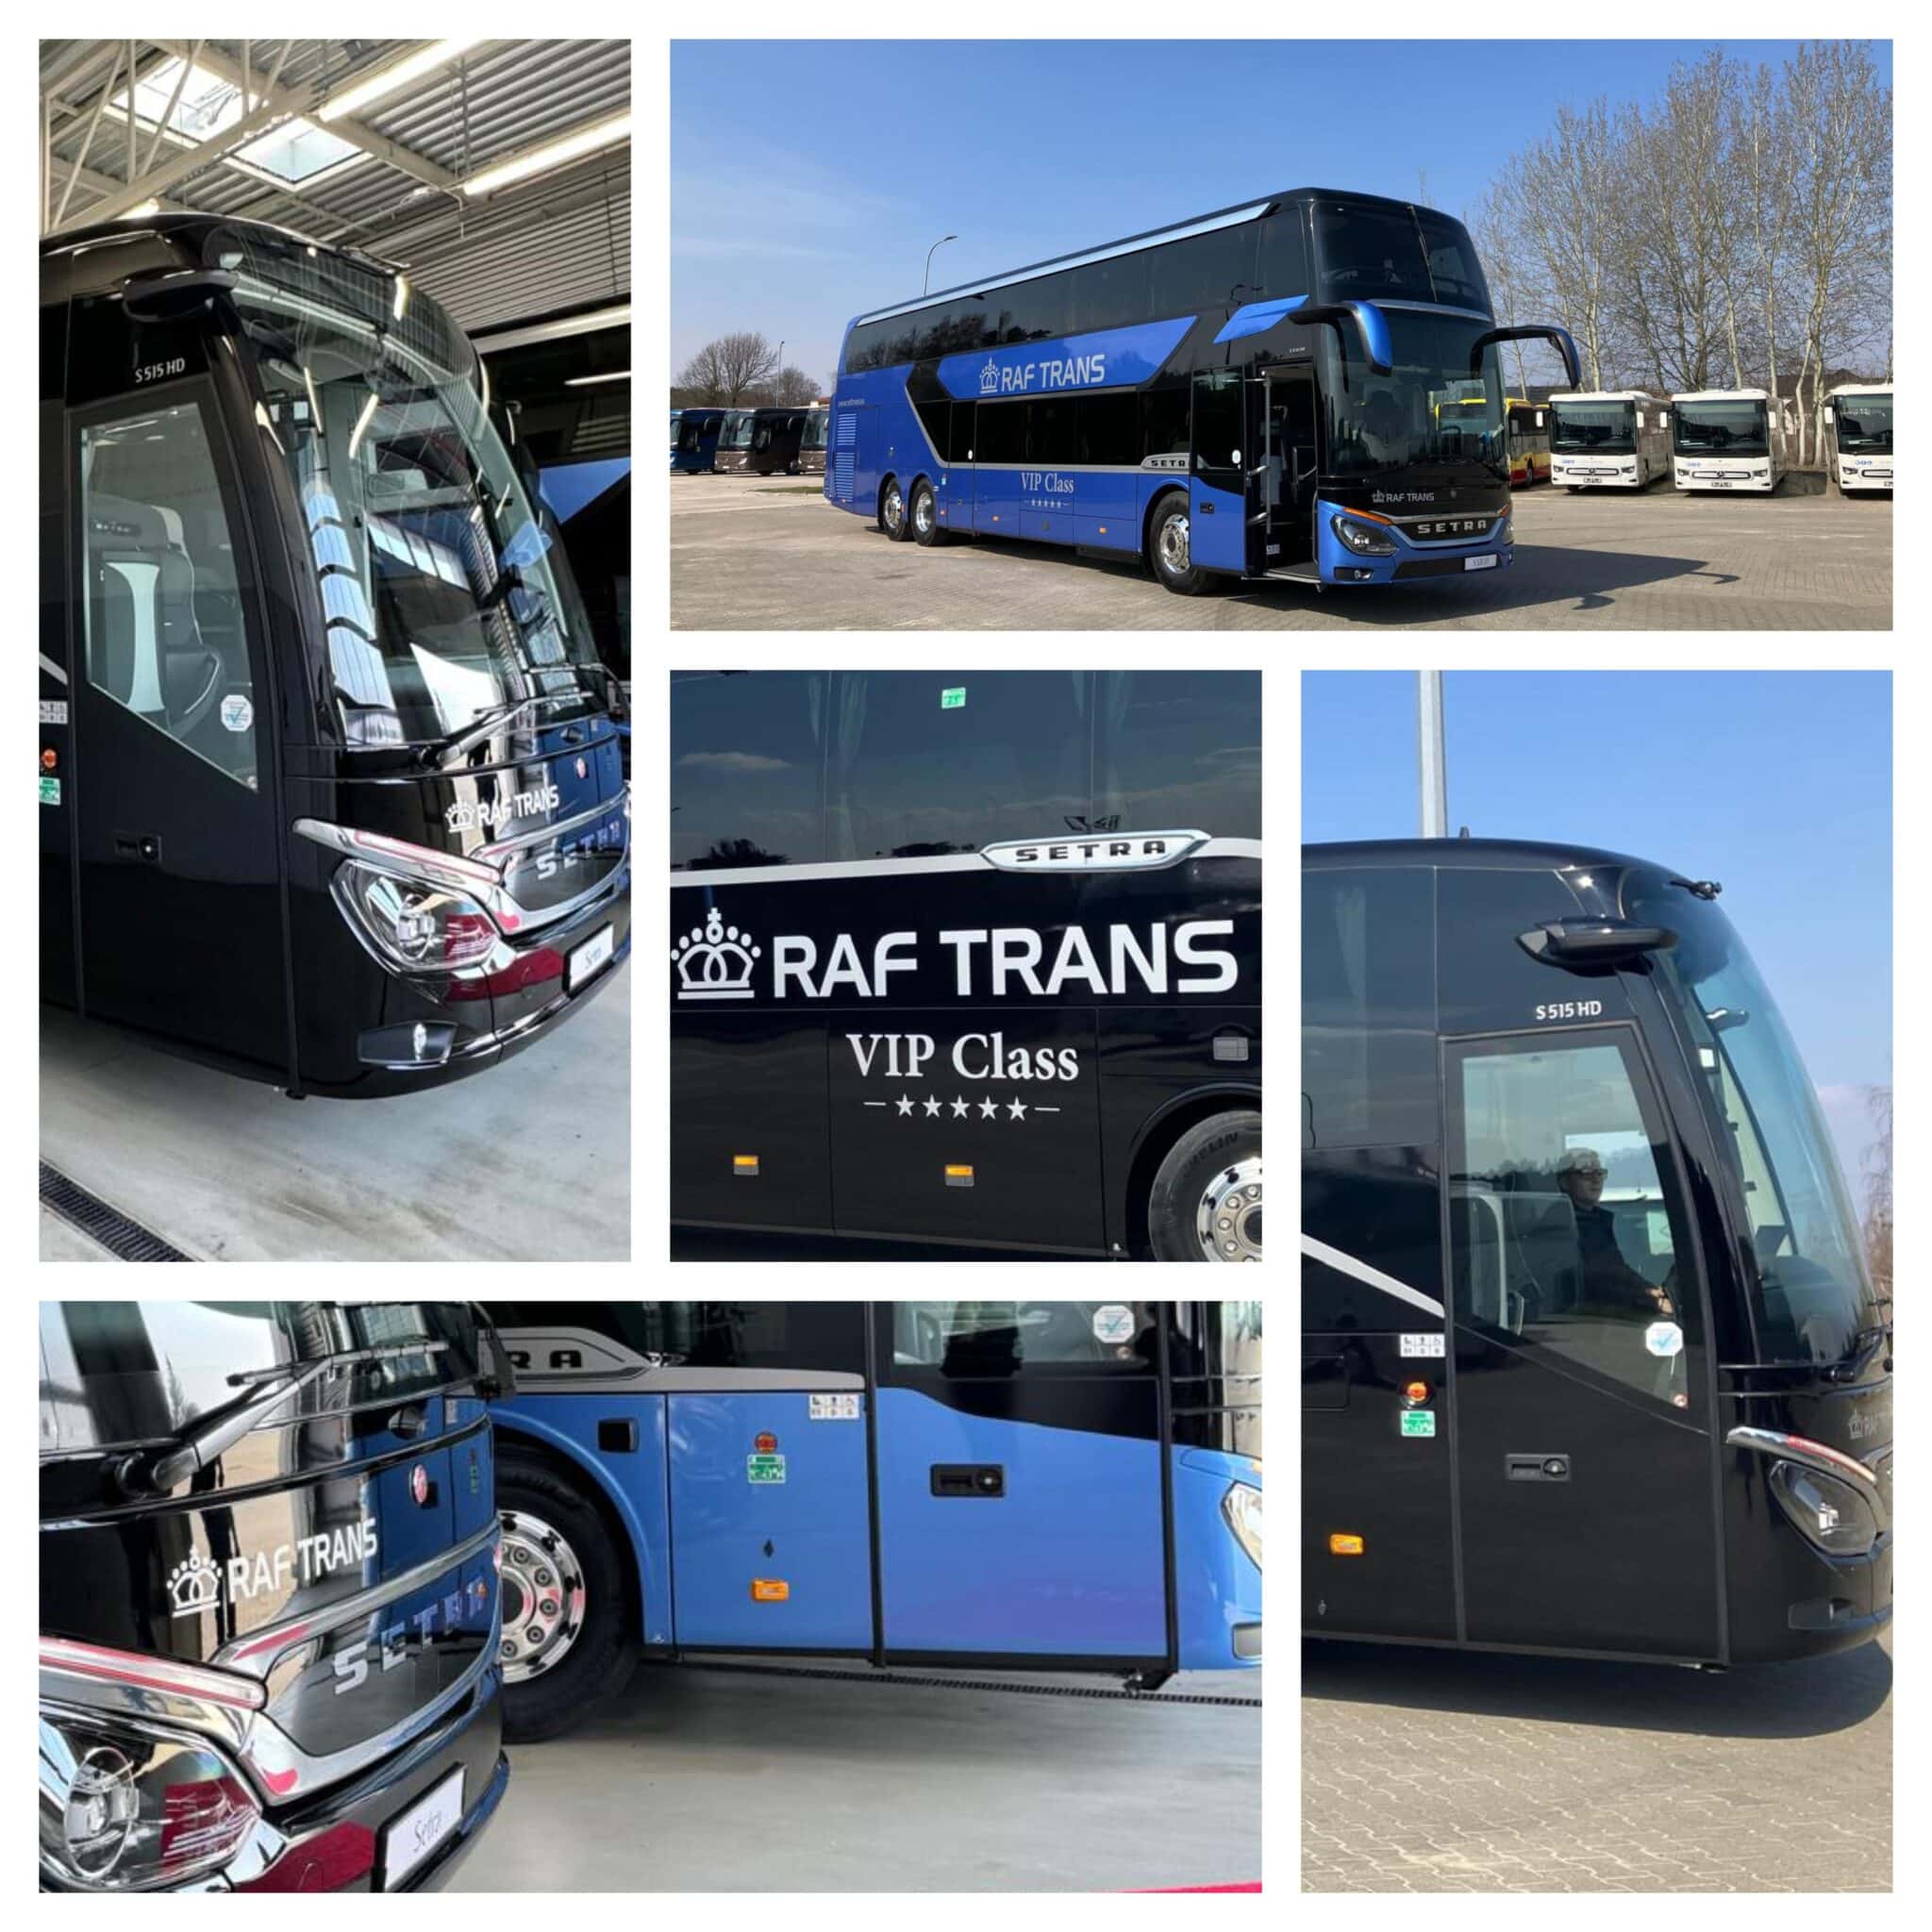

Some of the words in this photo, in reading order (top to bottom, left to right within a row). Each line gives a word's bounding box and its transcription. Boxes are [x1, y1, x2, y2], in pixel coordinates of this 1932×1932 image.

[135, 368, 143, 384] S
[143, 362, 164, 381] 515
[165, 357, 186, 375] HD
[1002, 363, 1035, 391] RAF
[1040, 354, 1106, 389] TRANS
[1151, 459, 1187, 468] SETR
[1019, 472, 1041, 491] VIP
[1044, 472, 1074, 493] Class
[1386, 491, 1405, 502] RAF
[1406, 491, 1435, 502] TRANS
[1417, 520, 1487, 534] SETRA
[476, 798, 513, 826] RAF
[514, 785, 560, 818] TRANS
[1015, 840, 1166, 862] SETRA
[774, 930, 918, 998] RAF
[939, 920, 1240, 996] TRANS
[1536, 1005, 1546, 1020] S
[1548, 1002, 1574, 1020] 515
[1576, 1000, 1602, 1017] HD
[846, 1032, 936, 1077] VIP
[952, 1030, 1079, 1081] Class
[227, 1544, 291, 1603] RAF
[297, 1518, 377, 1580] TRANS
